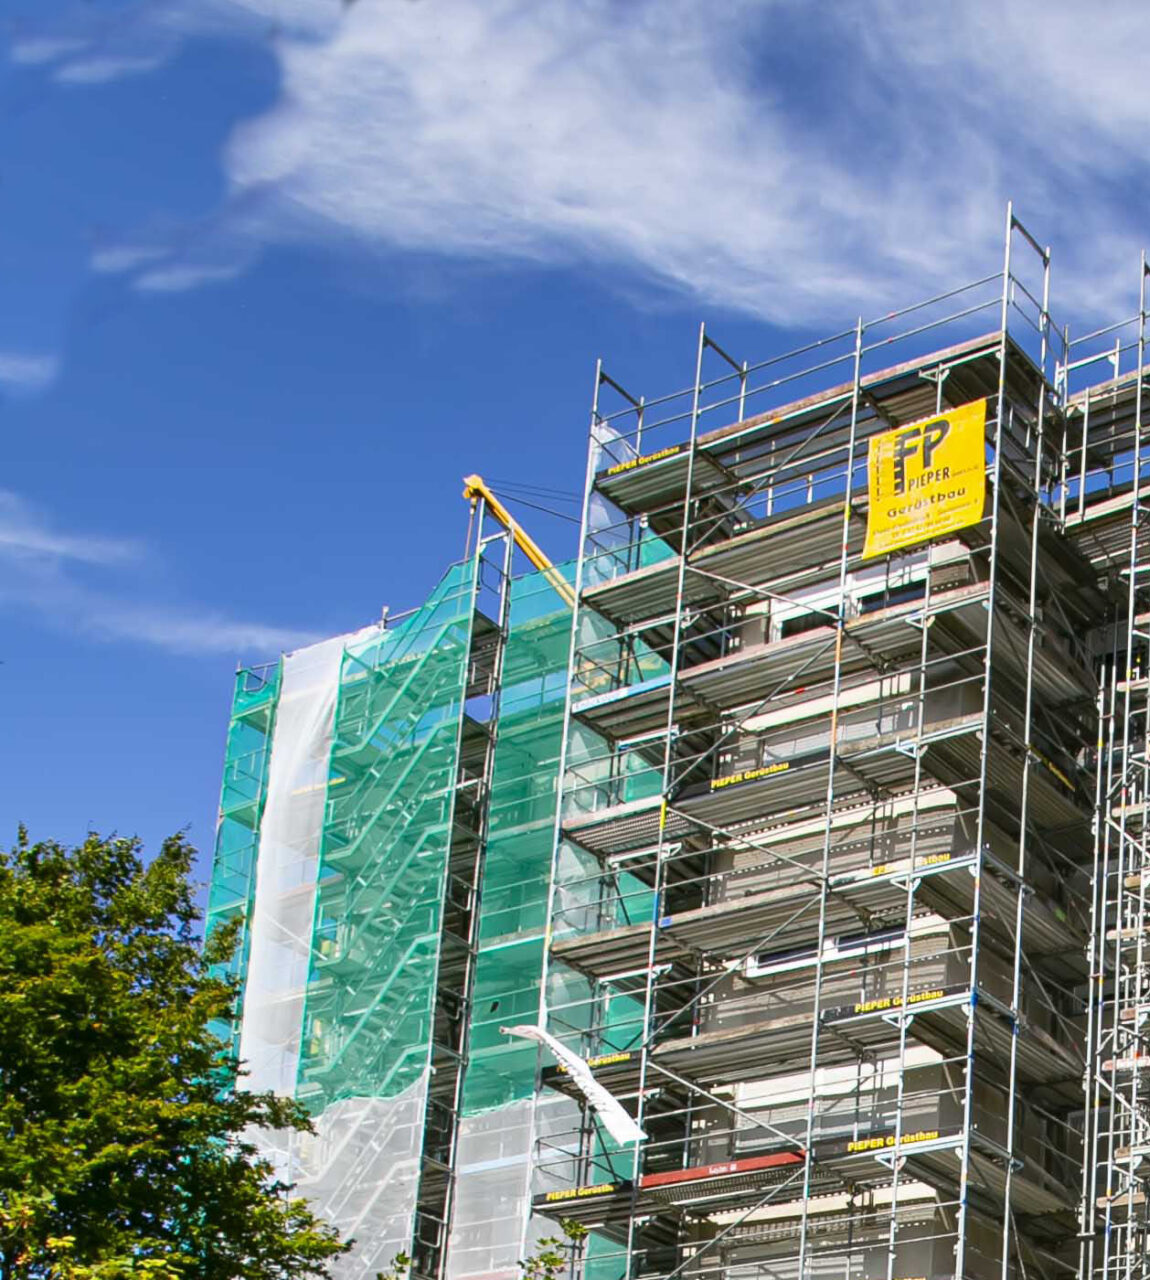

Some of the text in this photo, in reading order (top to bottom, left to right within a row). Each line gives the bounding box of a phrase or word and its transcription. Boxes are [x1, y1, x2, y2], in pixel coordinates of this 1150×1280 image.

[893, 419, 951, 496] FP
[908, 466, 951, 492] PIEPER
[887, 487, 966, 518] Gerüstbau
[711, 762, 789, 789] PIEPER Gerüstbau
[854, 997, 890, 1013] PIEPER
[847, 1137, 884, 1152] PIEPER
[546, 1189, 577, 1201] PIEPER
